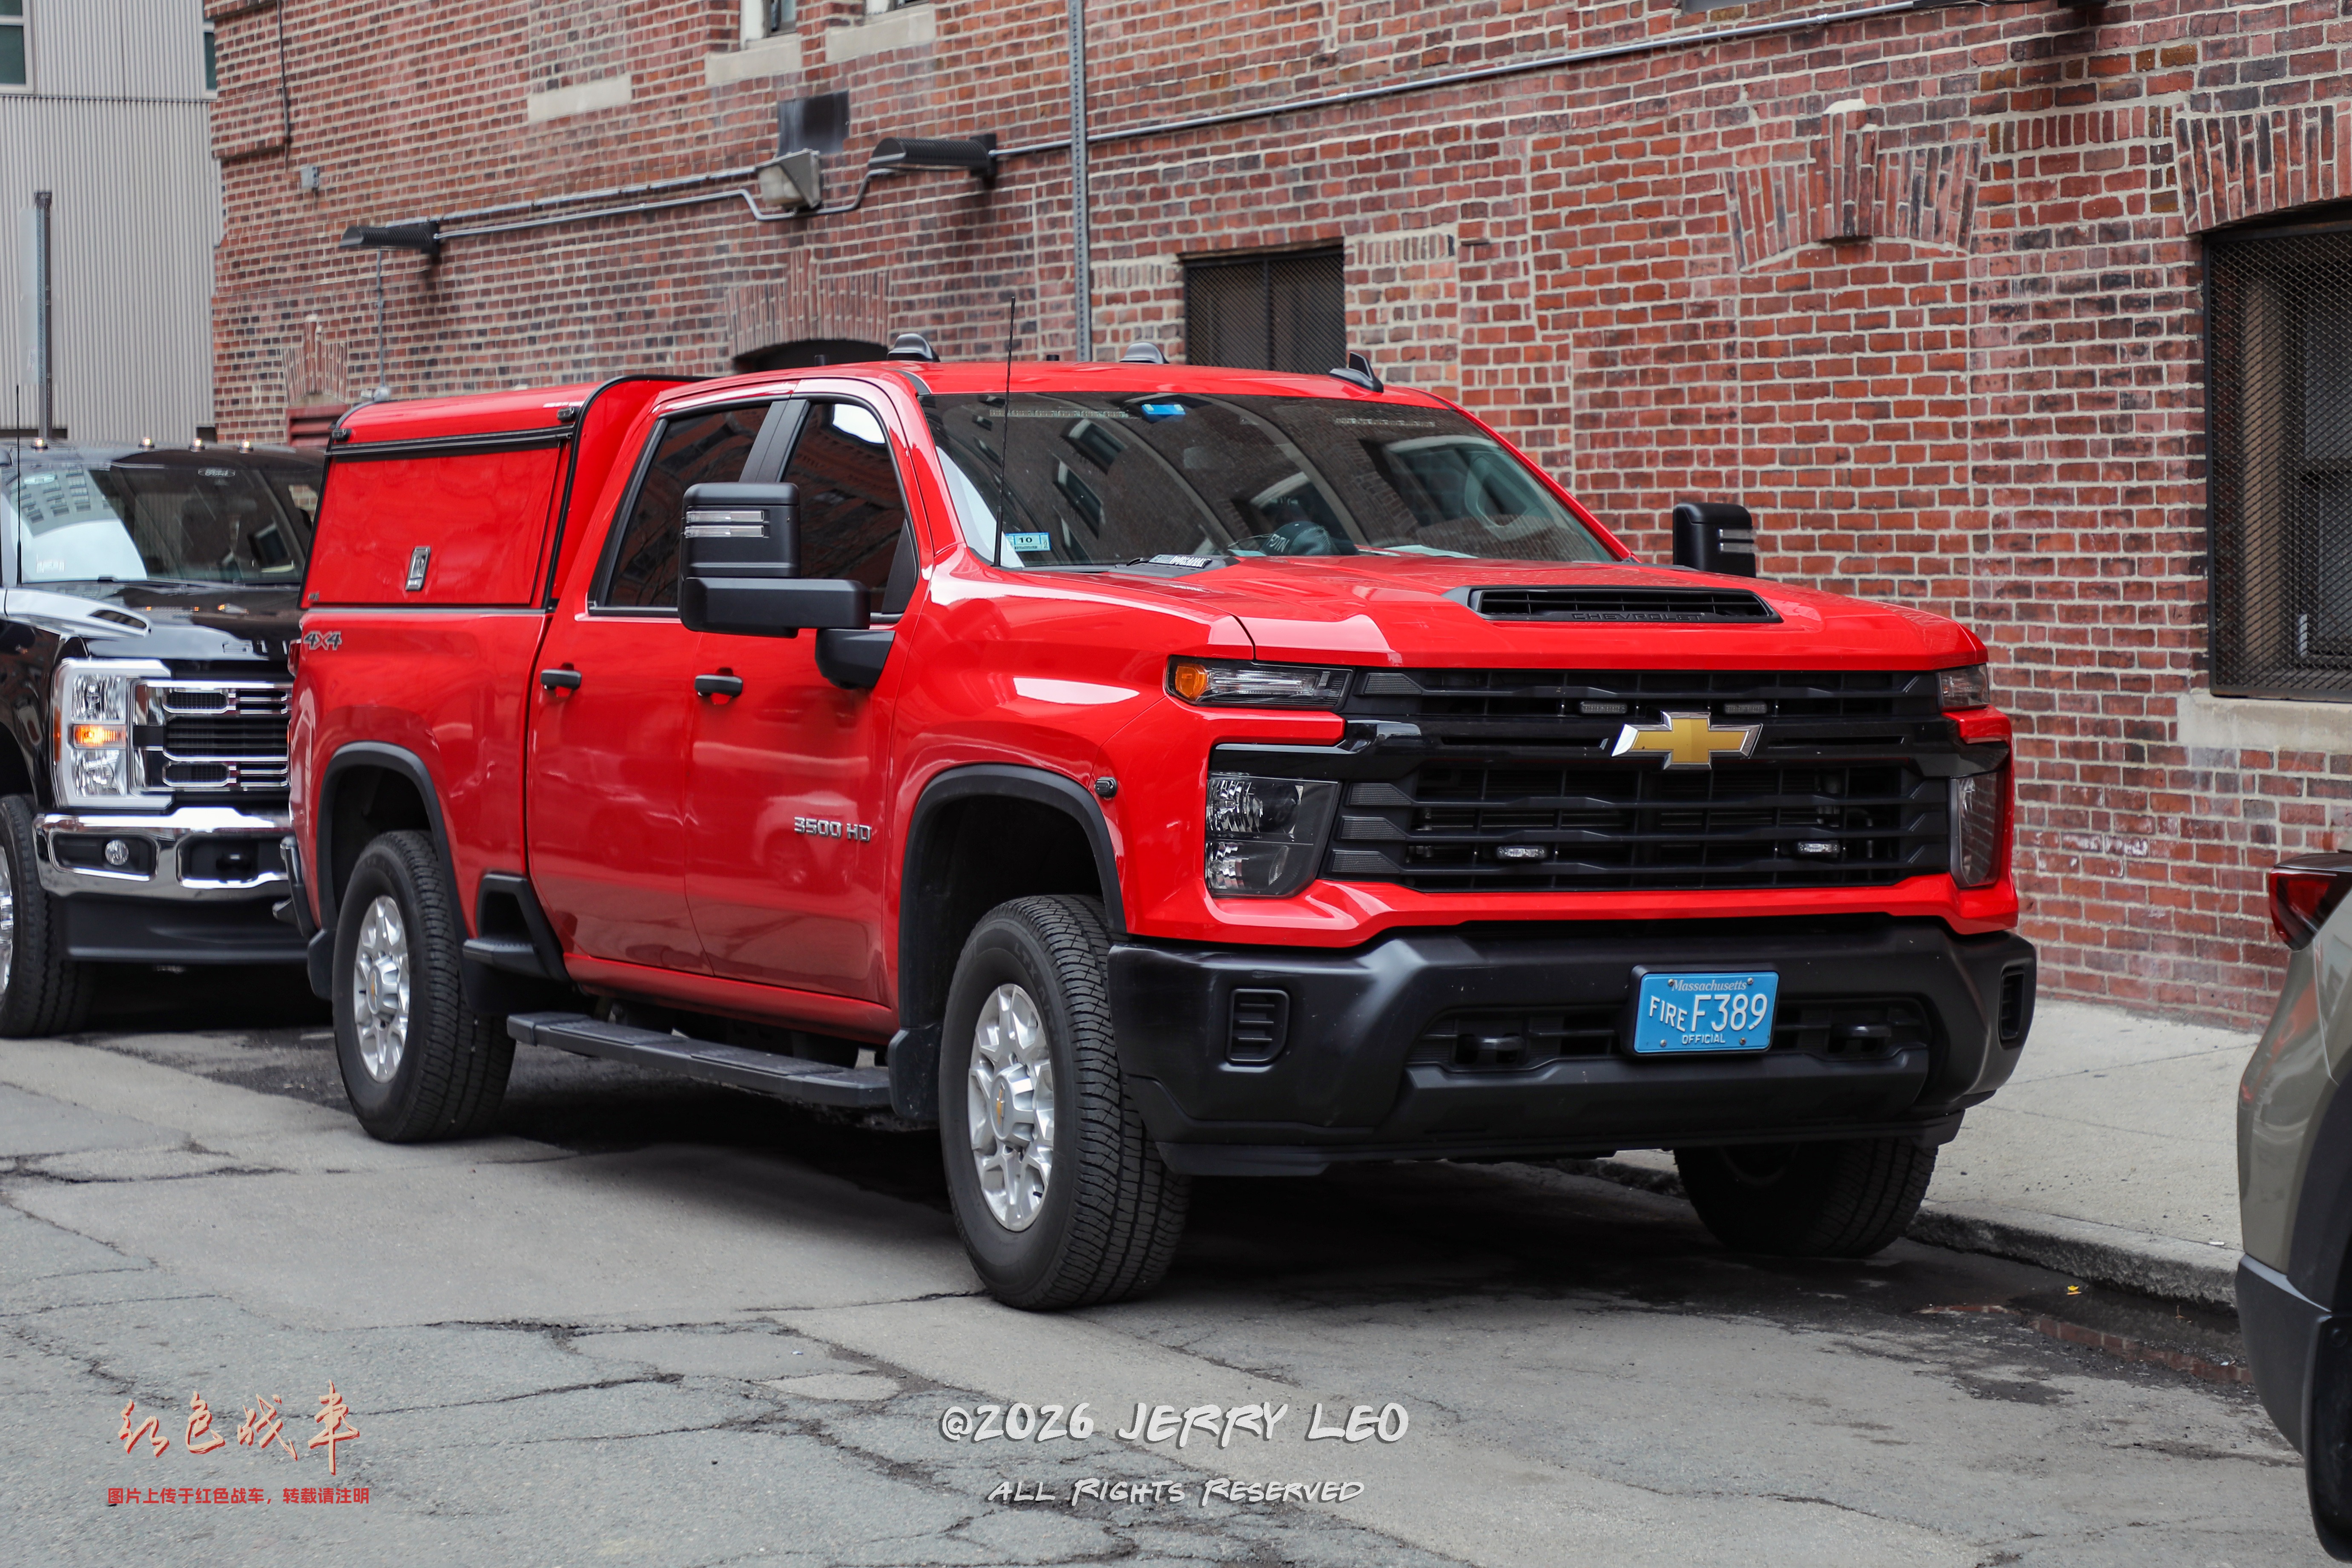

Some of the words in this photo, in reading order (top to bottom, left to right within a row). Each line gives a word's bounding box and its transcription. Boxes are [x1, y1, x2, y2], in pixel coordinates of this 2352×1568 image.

[794, 816, 841, 838] 3500
[847, 823, 871, 841] HD
[1671, 979, 1747, 991] Massachusetts
[1649, 995, 1688, 1032] FIRE
[1691, 994, 1768, 1032] F389
[1682, 1034, 1726, 1045] OFFICIAL
